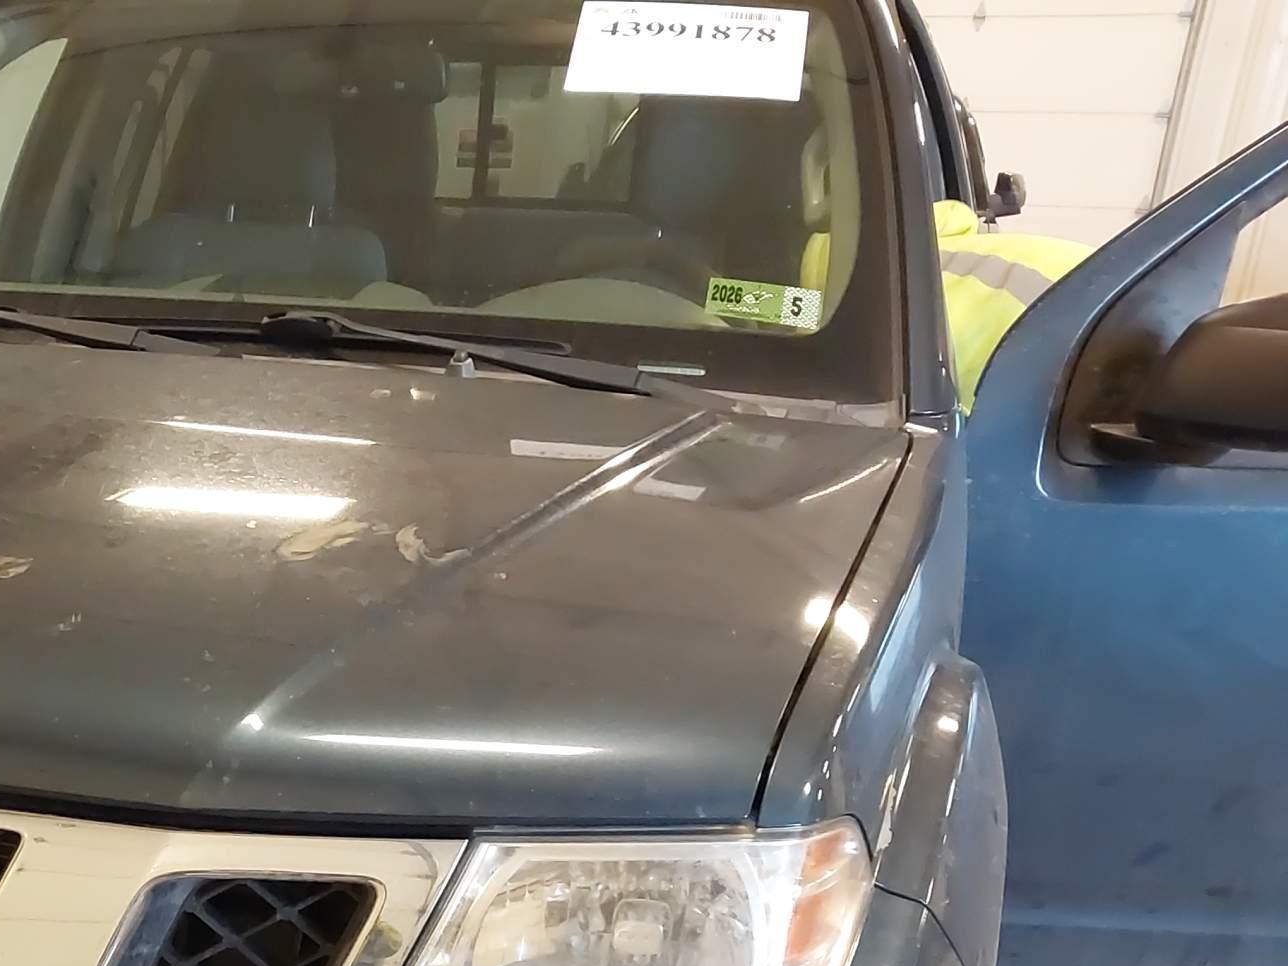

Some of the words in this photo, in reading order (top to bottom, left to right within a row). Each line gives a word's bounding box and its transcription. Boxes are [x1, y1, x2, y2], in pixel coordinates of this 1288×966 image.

[601, 21, 776, 42] 43991878
[711, 284, 743, 304] 2026
[791, 297, 803, 317] 5
